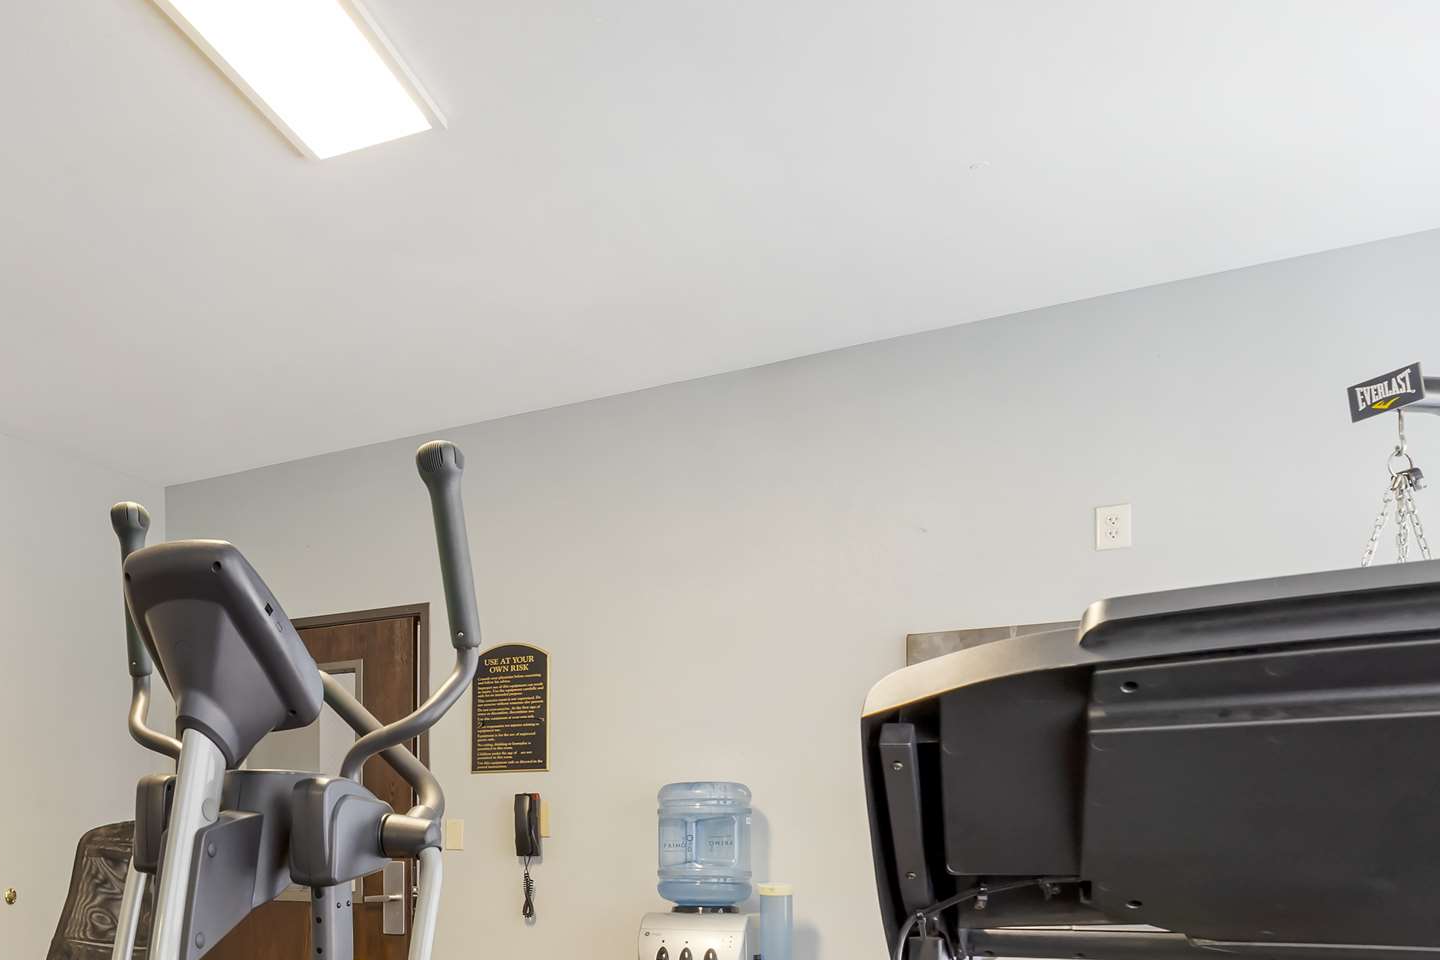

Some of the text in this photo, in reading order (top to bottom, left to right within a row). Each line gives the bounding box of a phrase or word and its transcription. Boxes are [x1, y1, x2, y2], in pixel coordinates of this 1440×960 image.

[1355, 368, 1416, 411] EVERLAST
[484, 655, 534, 666] USE AT YOUR
[489, 663, 529, 674] OWN RISK
